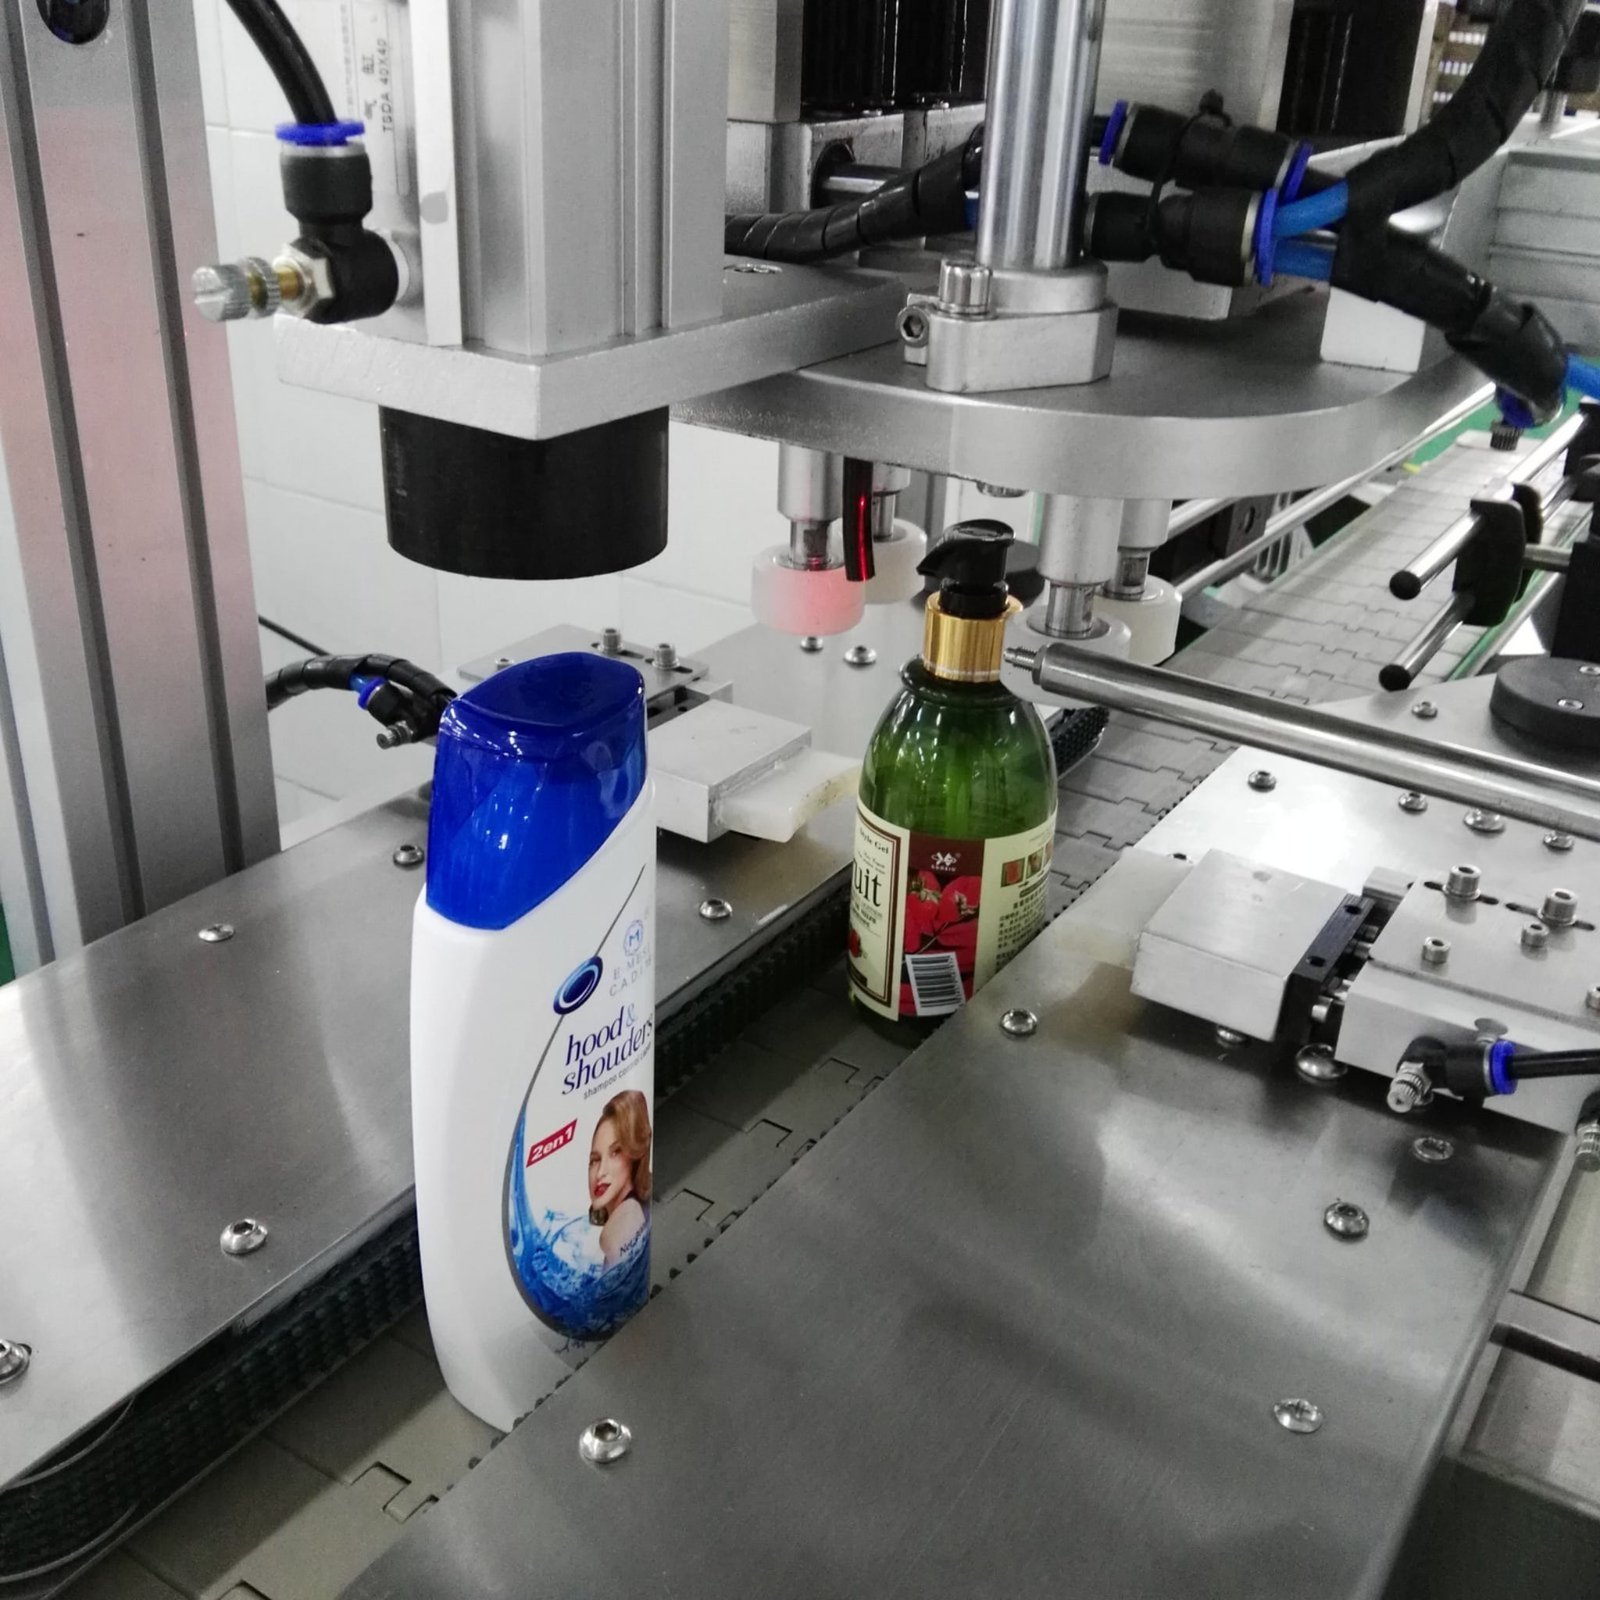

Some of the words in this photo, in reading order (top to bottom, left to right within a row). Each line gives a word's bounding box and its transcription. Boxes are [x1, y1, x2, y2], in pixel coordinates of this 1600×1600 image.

[874, 839, 889, 854] Gel
[561, 1013, 653, 1095] shouders
[565, 1005, 625, 1066] hood
[583, 1073, 618, 1100] shampoo
